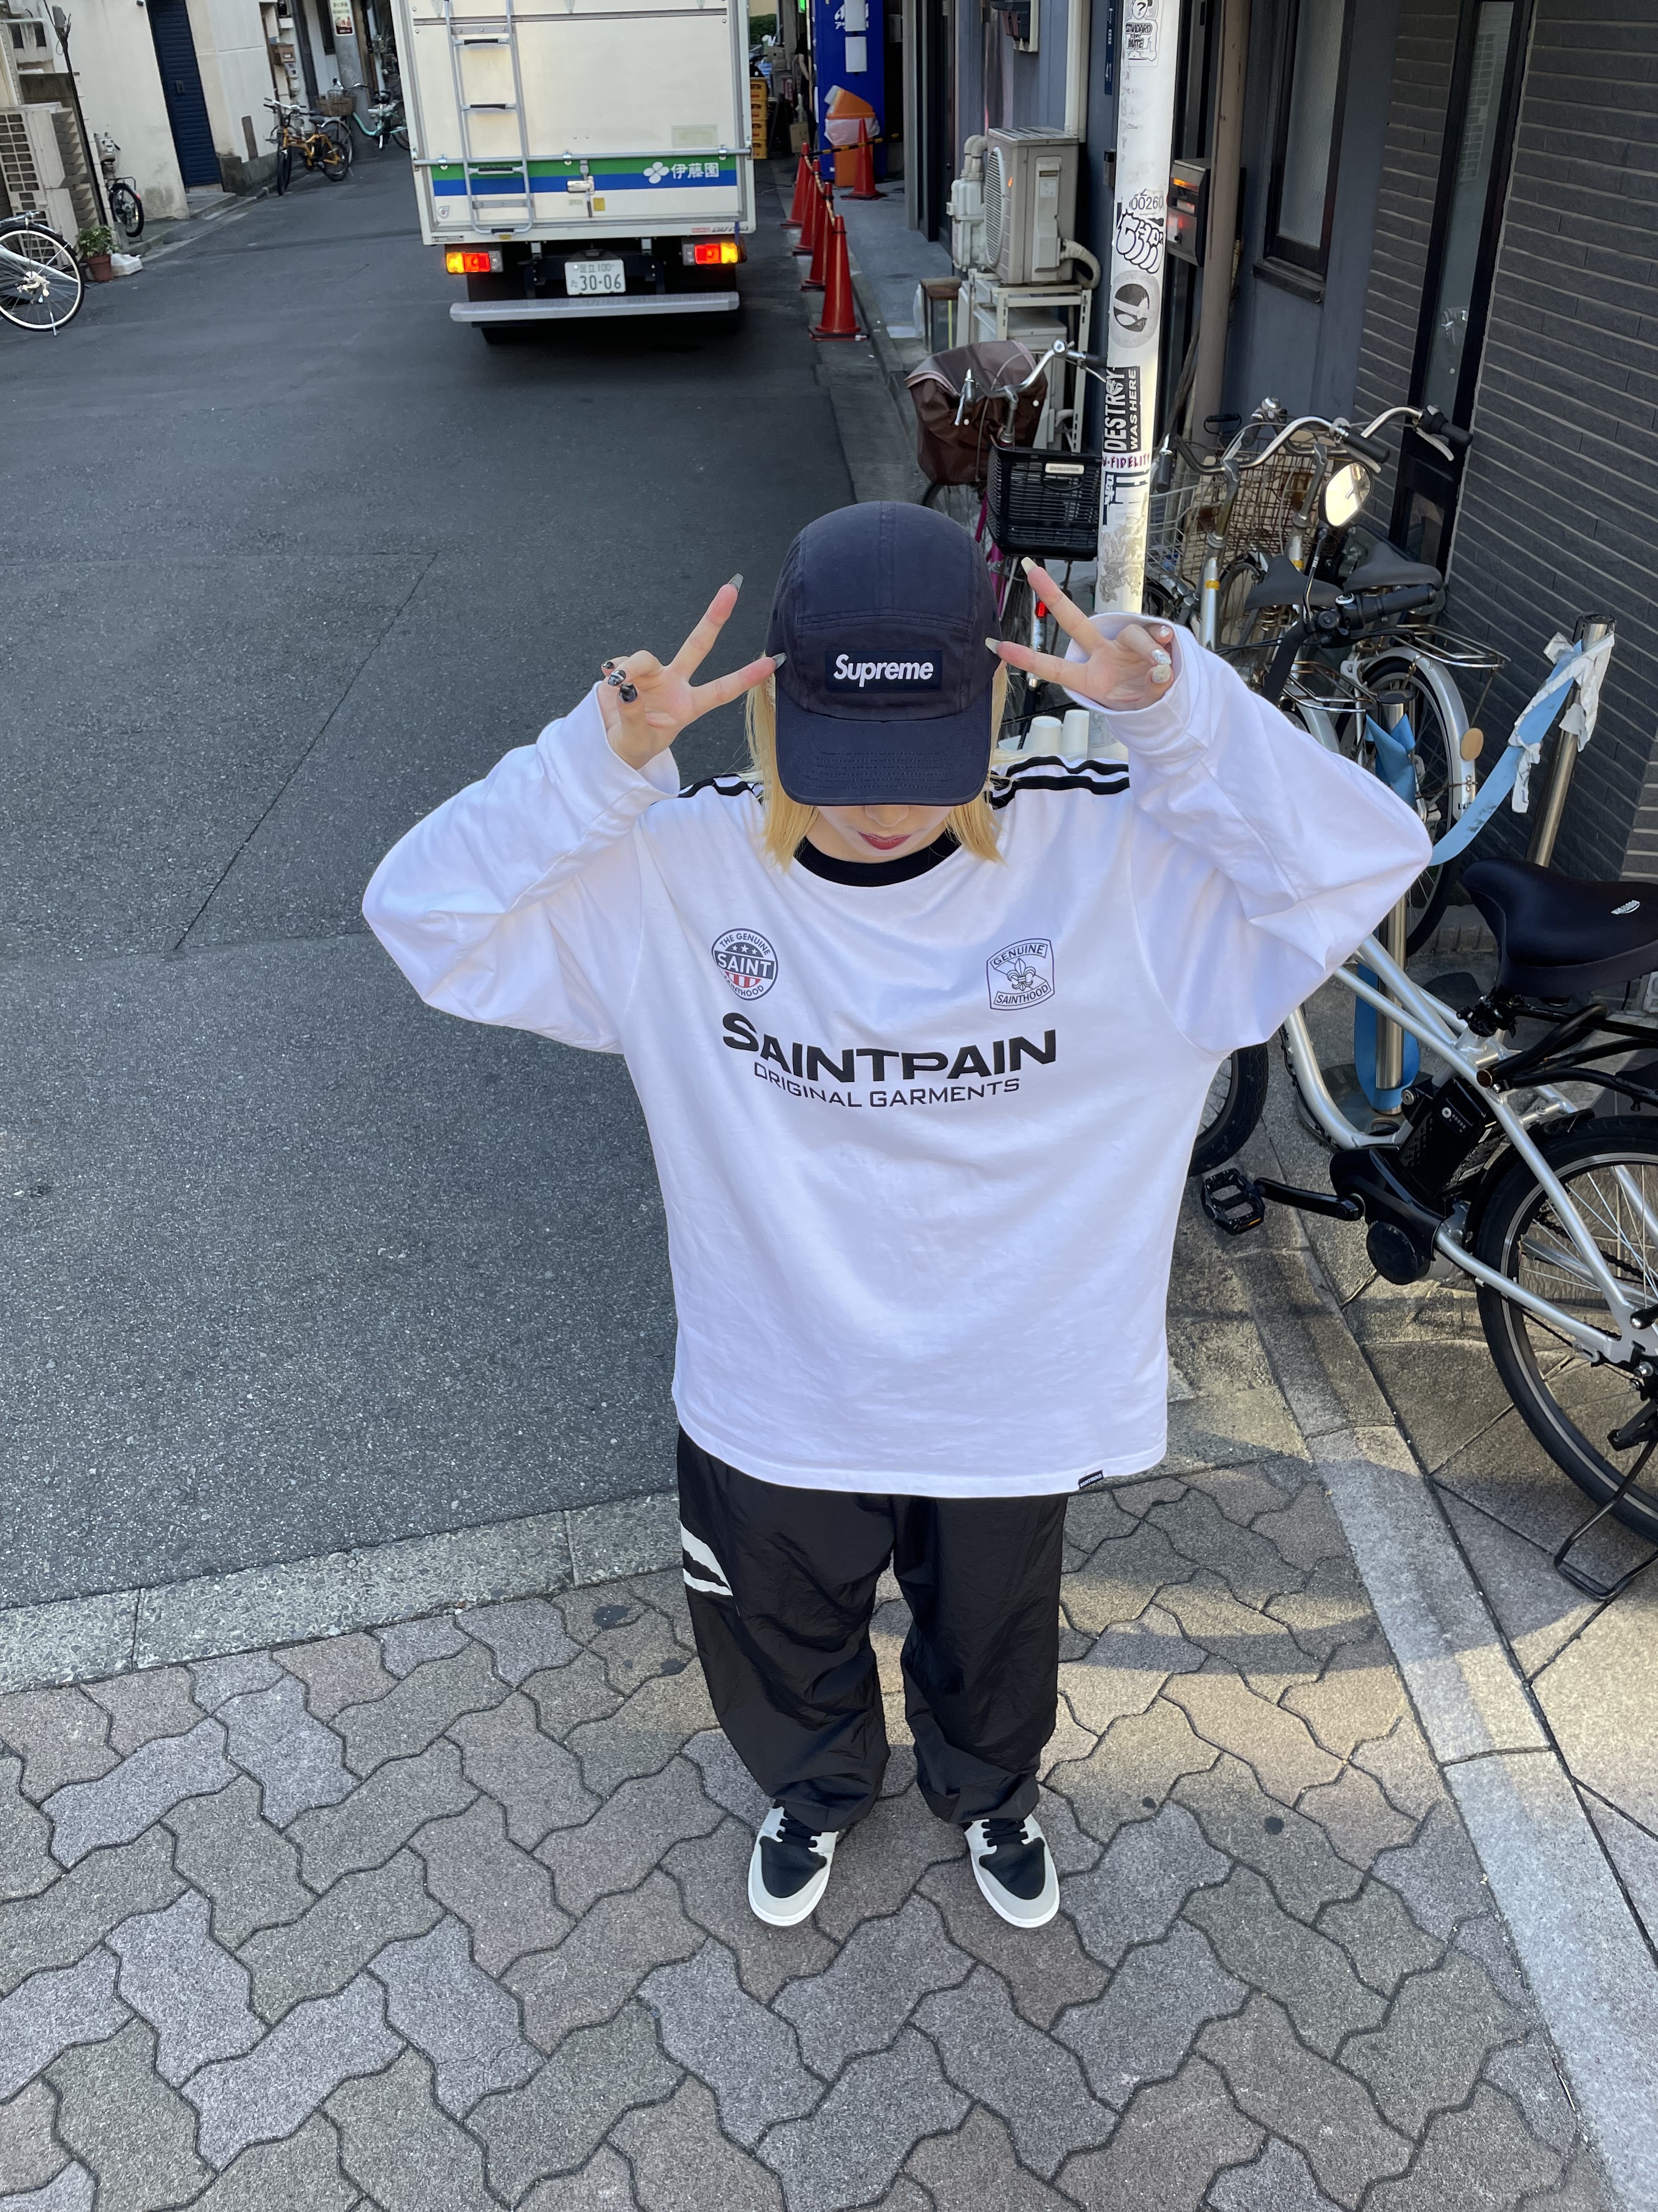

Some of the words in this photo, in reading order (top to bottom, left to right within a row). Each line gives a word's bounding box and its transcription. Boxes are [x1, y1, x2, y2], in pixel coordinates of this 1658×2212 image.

[670, 162, 719, 179] 伊藤園
[1128, 369, 1137, 411] HERE
[1130, 414, 1138, 450] WAS
[833, 654, 934, 687] Supreme
[719, 934, 735, 947] THE
[736, 933, 771, 956] GENUINE
[994, 944, 1045, 965] GENUINE
[717, 953, 771, 977] SAINT
[996, 984, 1048, 1005] SAINTHOOD
[723, 1012, 1056, 1083] SAINTPAIN
[754, 1062, 862, 1107] ORIGINAL
[870, 1077, 1020, 1107] GARMENTS
